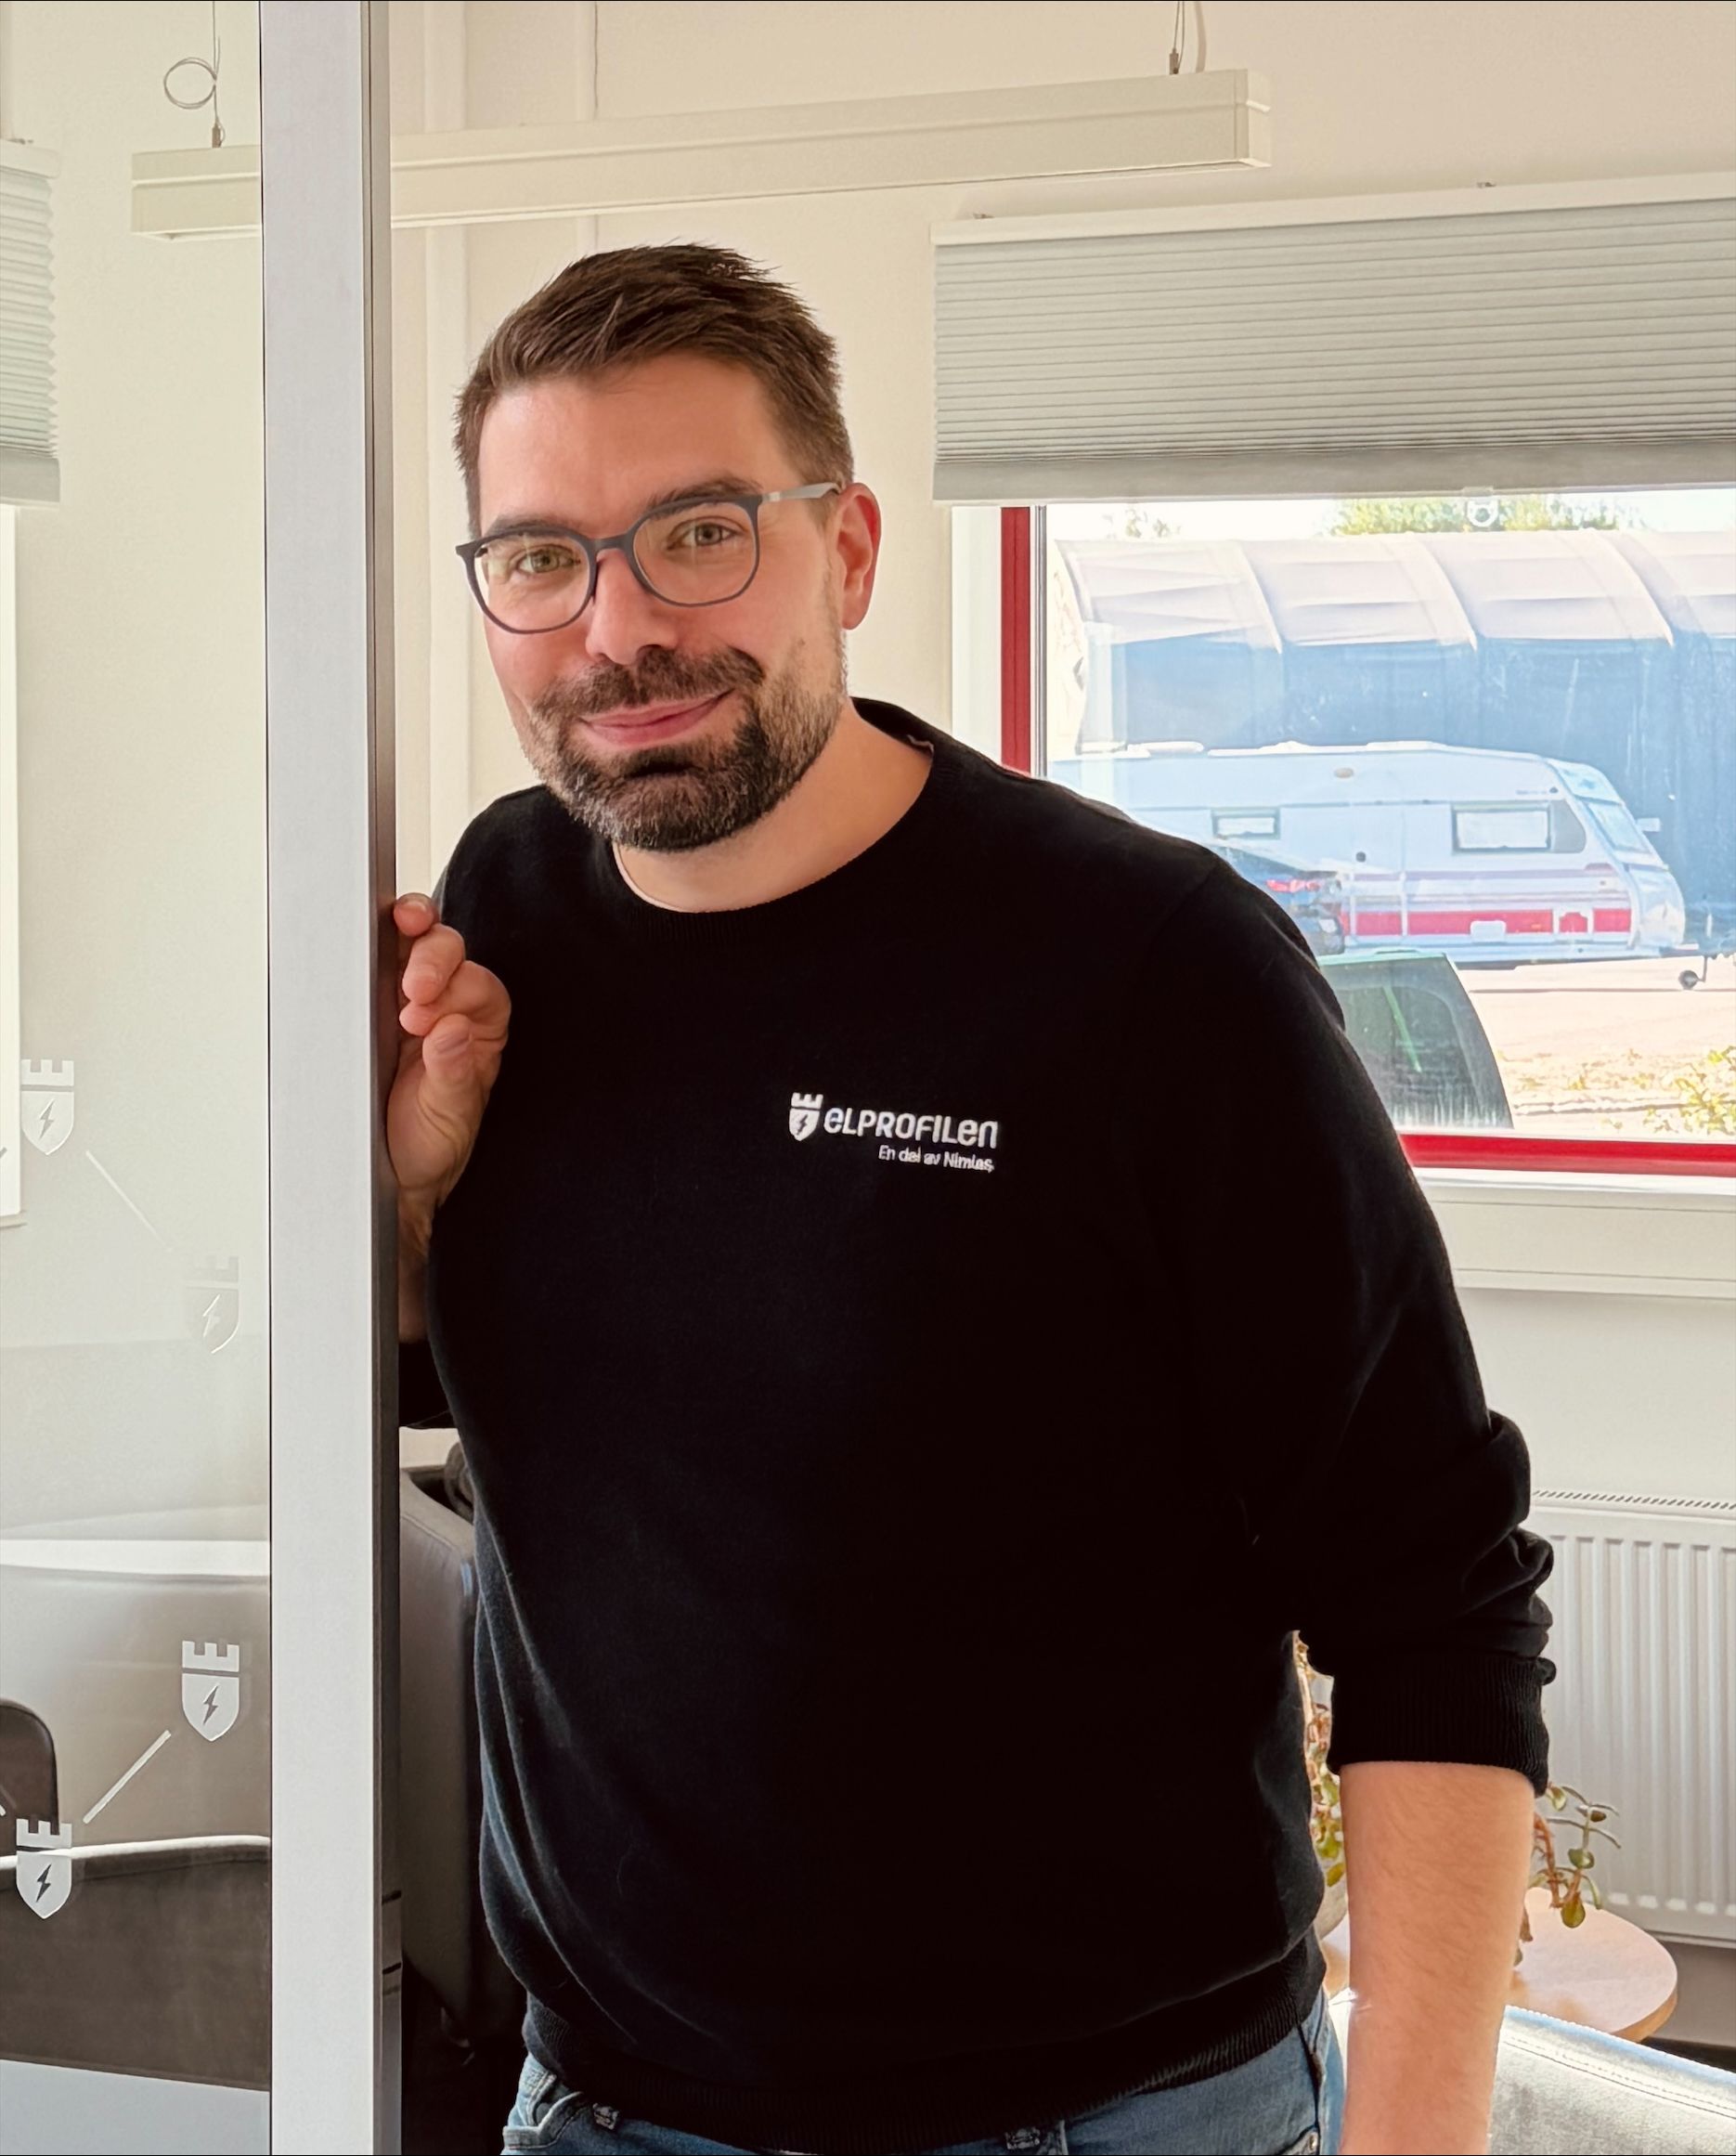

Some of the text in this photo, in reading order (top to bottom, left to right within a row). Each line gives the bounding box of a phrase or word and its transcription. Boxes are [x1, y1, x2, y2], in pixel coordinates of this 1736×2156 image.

[878, 1144, 897, 1161] En
[898, 1147, 922, 1163] del
[923, 1152, 941, 1165] av
